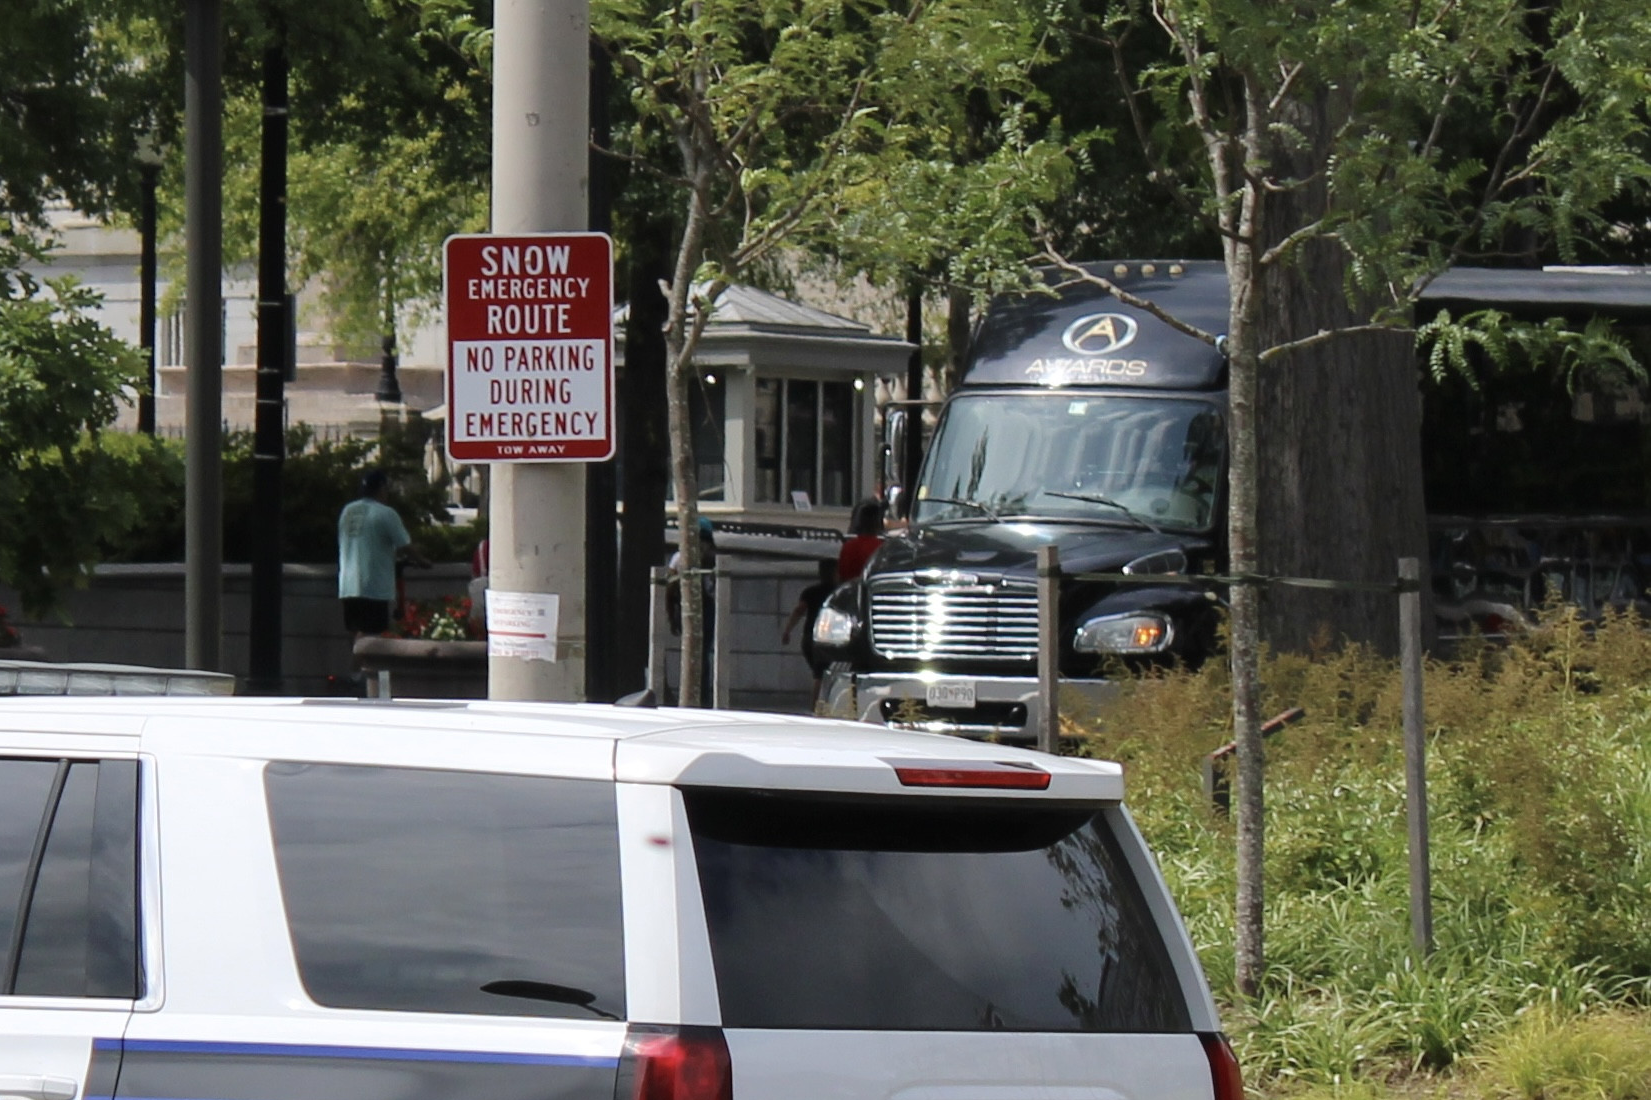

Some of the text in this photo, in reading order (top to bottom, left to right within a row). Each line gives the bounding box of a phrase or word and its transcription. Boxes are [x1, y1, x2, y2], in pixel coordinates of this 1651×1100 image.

[480, 245, 570, 276] SNOW
[468, 277, 590, 299] EMERGENCY
[487, 304, 571, 335] ROUTE
[467, 344, 595, 372] NO PARKING
[490, 378, 571, 404] DURING
[465, 411, 598, 438] EMERGENCY
[497, 444, 566, 455] TOW AWAY
